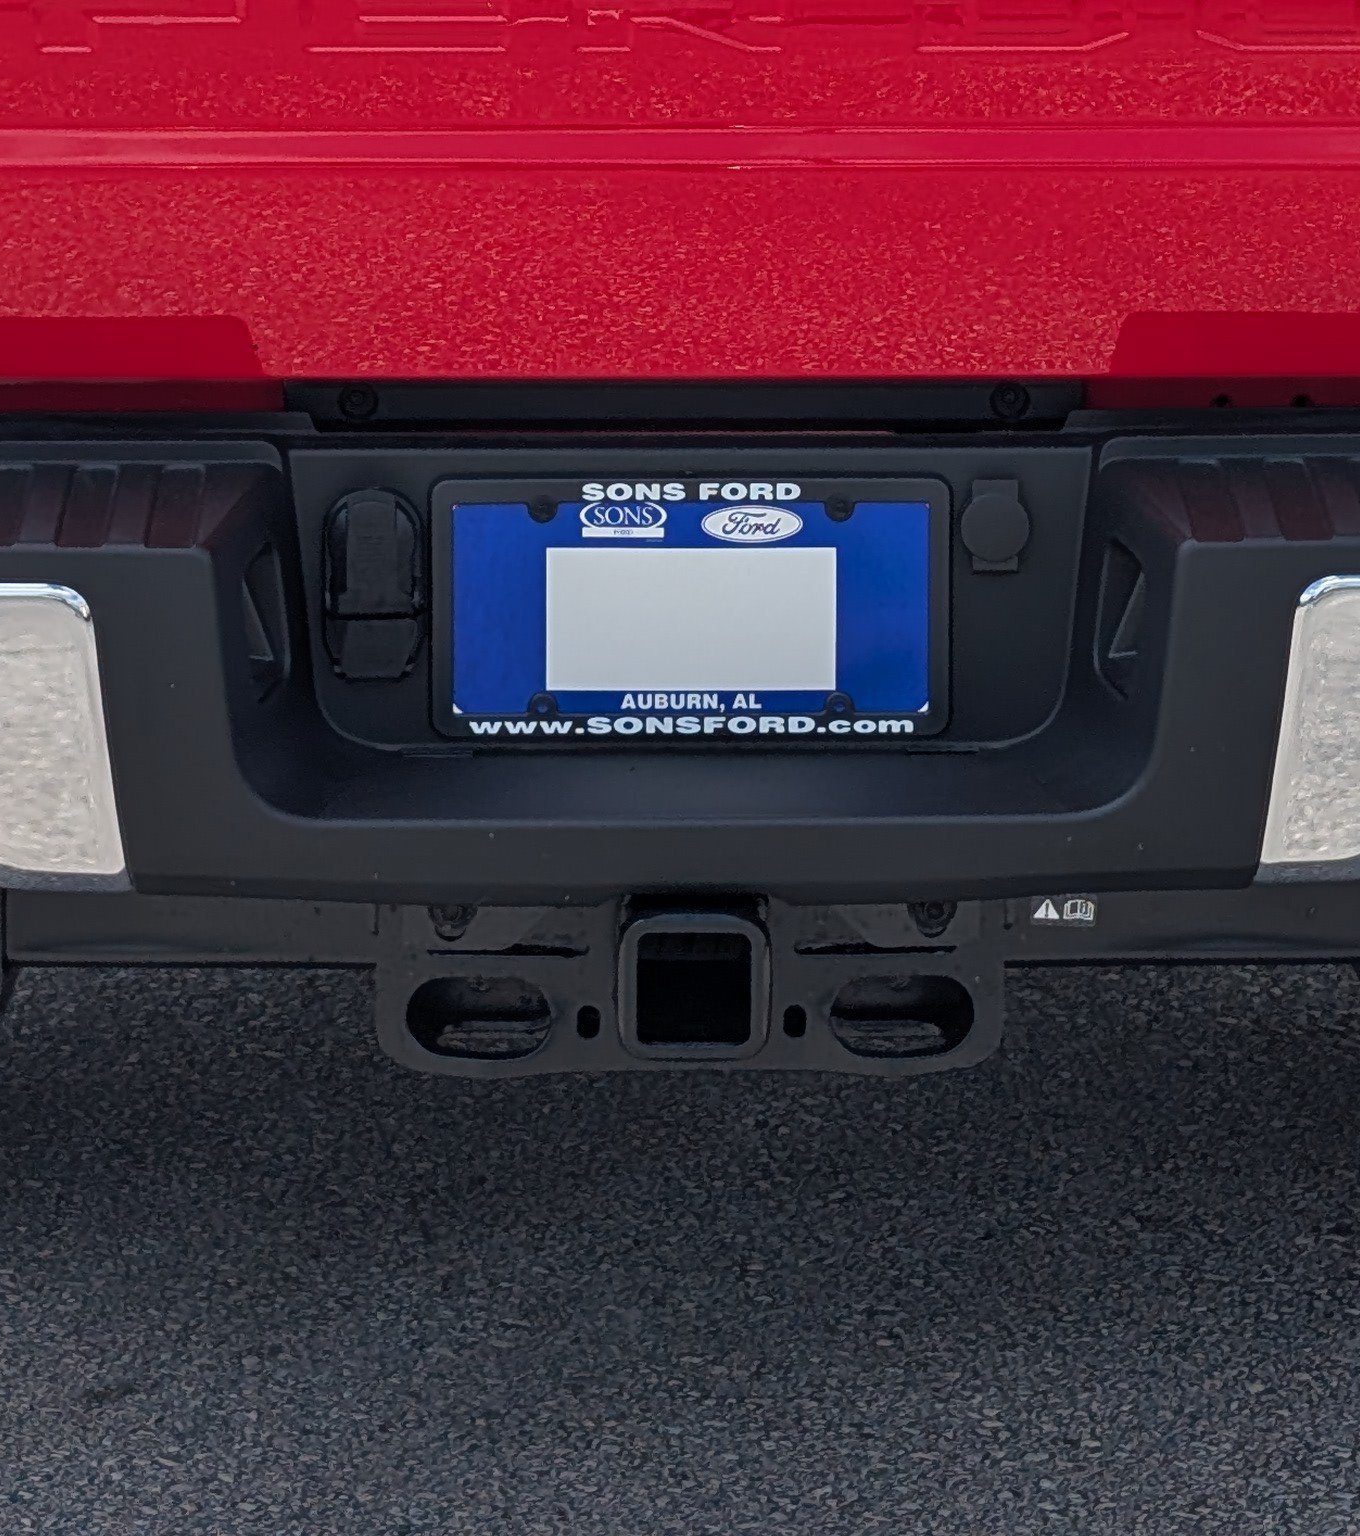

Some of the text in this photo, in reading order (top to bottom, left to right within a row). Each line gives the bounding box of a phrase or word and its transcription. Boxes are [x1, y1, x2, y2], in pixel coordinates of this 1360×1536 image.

[581, 482, 802, 502] SONS FORD
[592, 505, 654, 526] SONS
[721, 510, 782, 536] Ford
[620, 693, 763, 713] AUBURN, AL
[468, 715, 915, 736] www.SONSFORD.com
